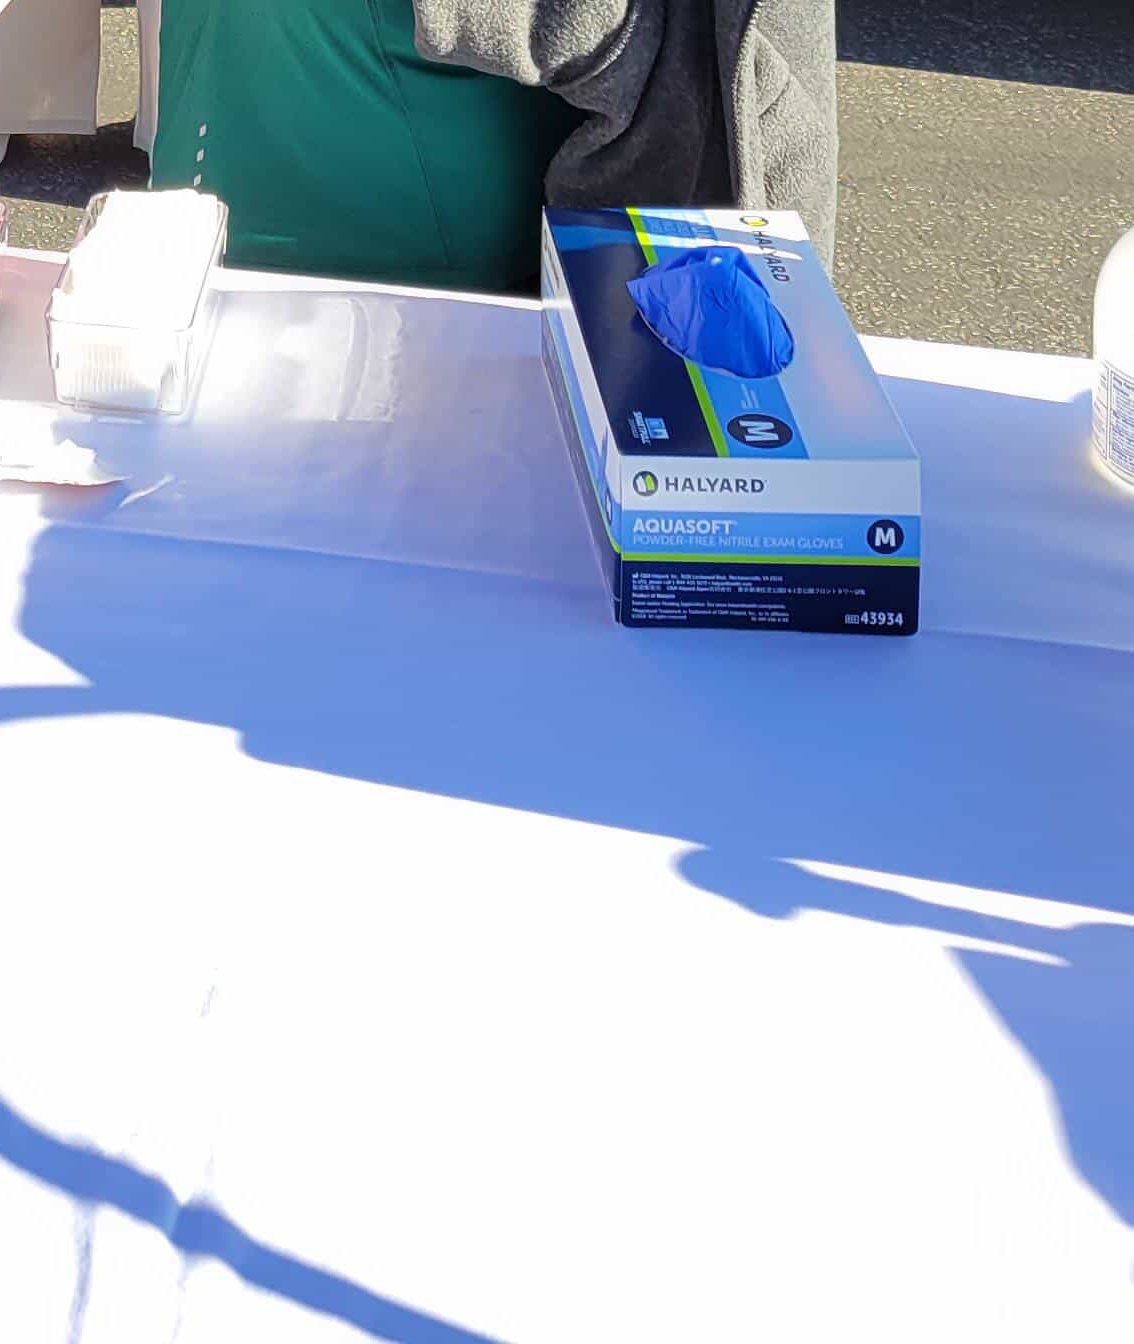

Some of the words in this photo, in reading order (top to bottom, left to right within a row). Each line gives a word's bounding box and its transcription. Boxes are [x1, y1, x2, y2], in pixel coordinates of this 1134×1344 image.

[739, 419, 780, 442] M
[665, 476, 765, 493] HALYARD
[633, 518, 733, 535] AQUASOFT
[633, 534, 717, 547] POWDER-FREE
[719, 535, 761, 548] NITRILE
[763, 536, 796, 549] EXAM
[797, 537, 844, 550] GLOVES
[874, 527, 897, 547] M
[860, 611, 905, 627] 43934
